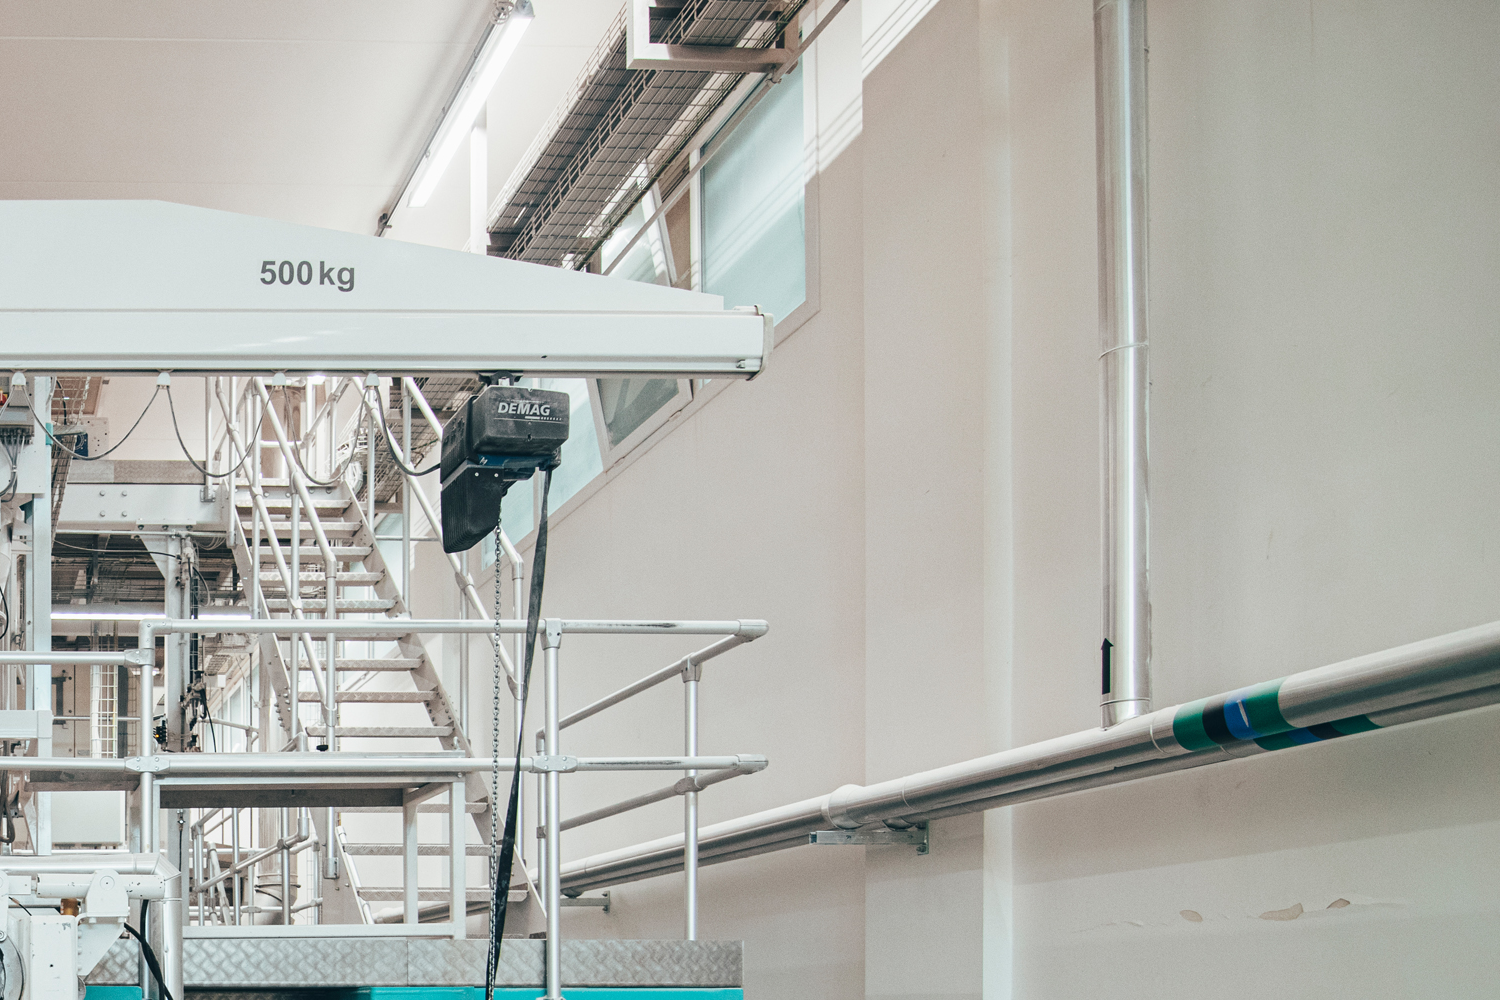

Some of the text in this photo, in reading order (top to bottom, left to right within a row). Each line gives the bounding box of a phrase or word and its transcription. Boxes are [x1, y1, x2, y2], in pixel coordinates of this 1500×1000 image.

[260, 260, 355, 292] 500 kg
[497, 402, 551, 416] DEMAG
